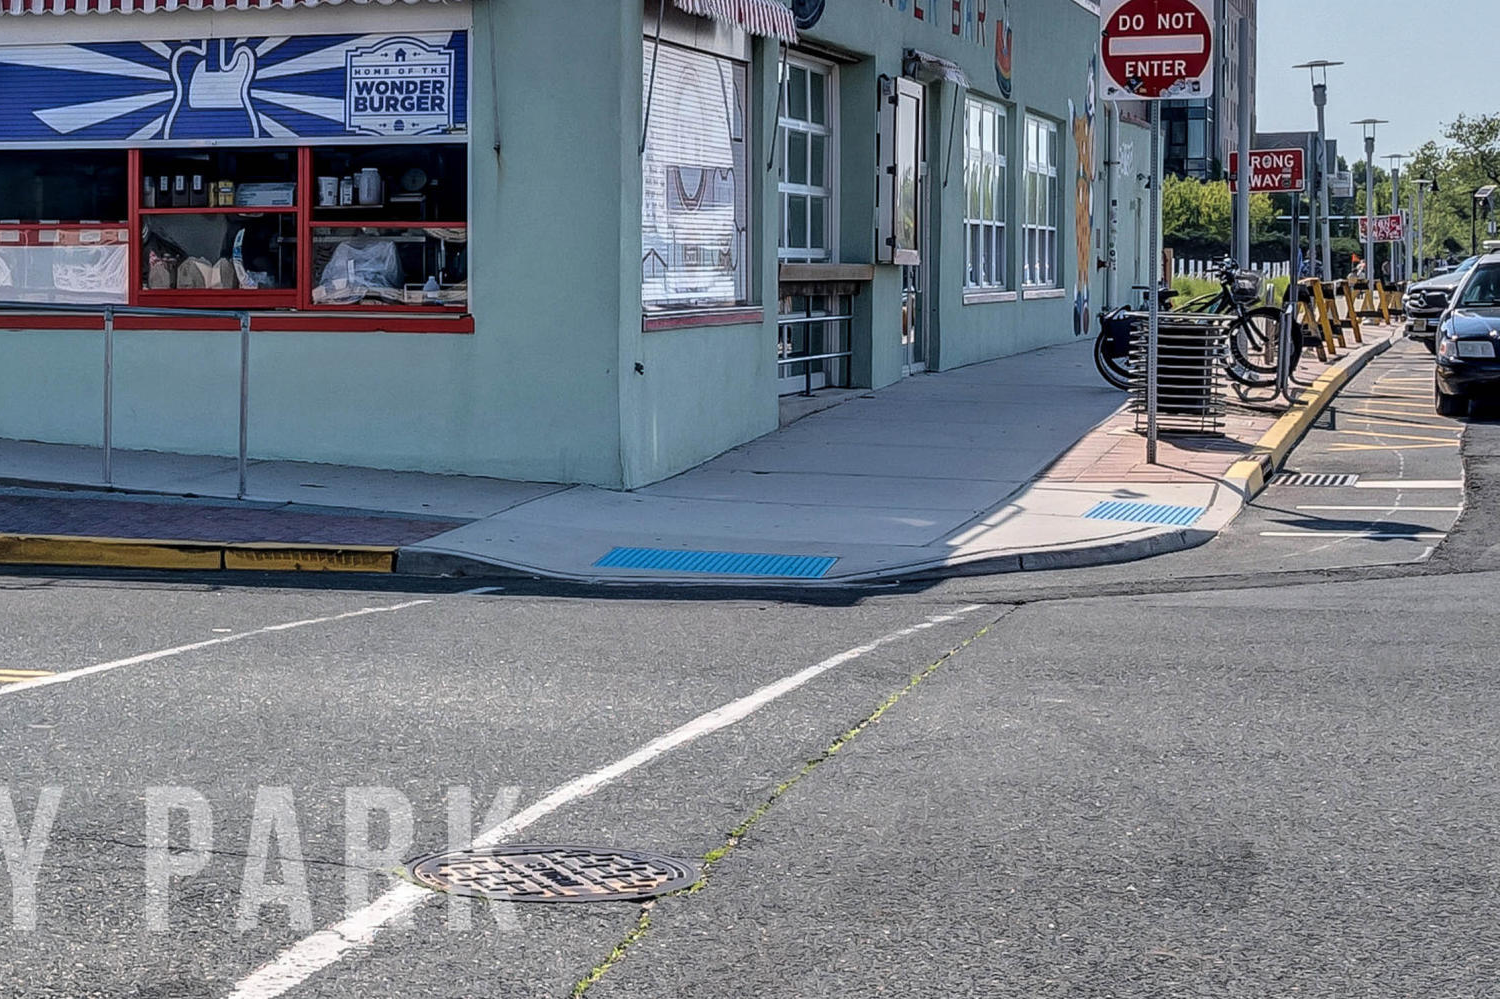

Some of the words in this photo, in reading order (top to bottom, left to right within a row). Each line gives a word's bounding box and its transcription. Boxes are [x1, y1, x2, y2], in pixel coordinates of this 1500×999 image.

[1118, 14, 1145, 31] DO
[1157, 12, 1196, 30] NOT
[354, 68, 390, 76] HOME
[398, 67, 414, 75] OF
[422, 66, 447, 74] THE
[1125, 60, 1187, 77] ENTER
[355, 80, 445, 95] WONDER
[354, 96, 445, 112] BURGER
[1250, 154, 1295, 169] RONG
[1250, 173, 1282, 188] WAY
